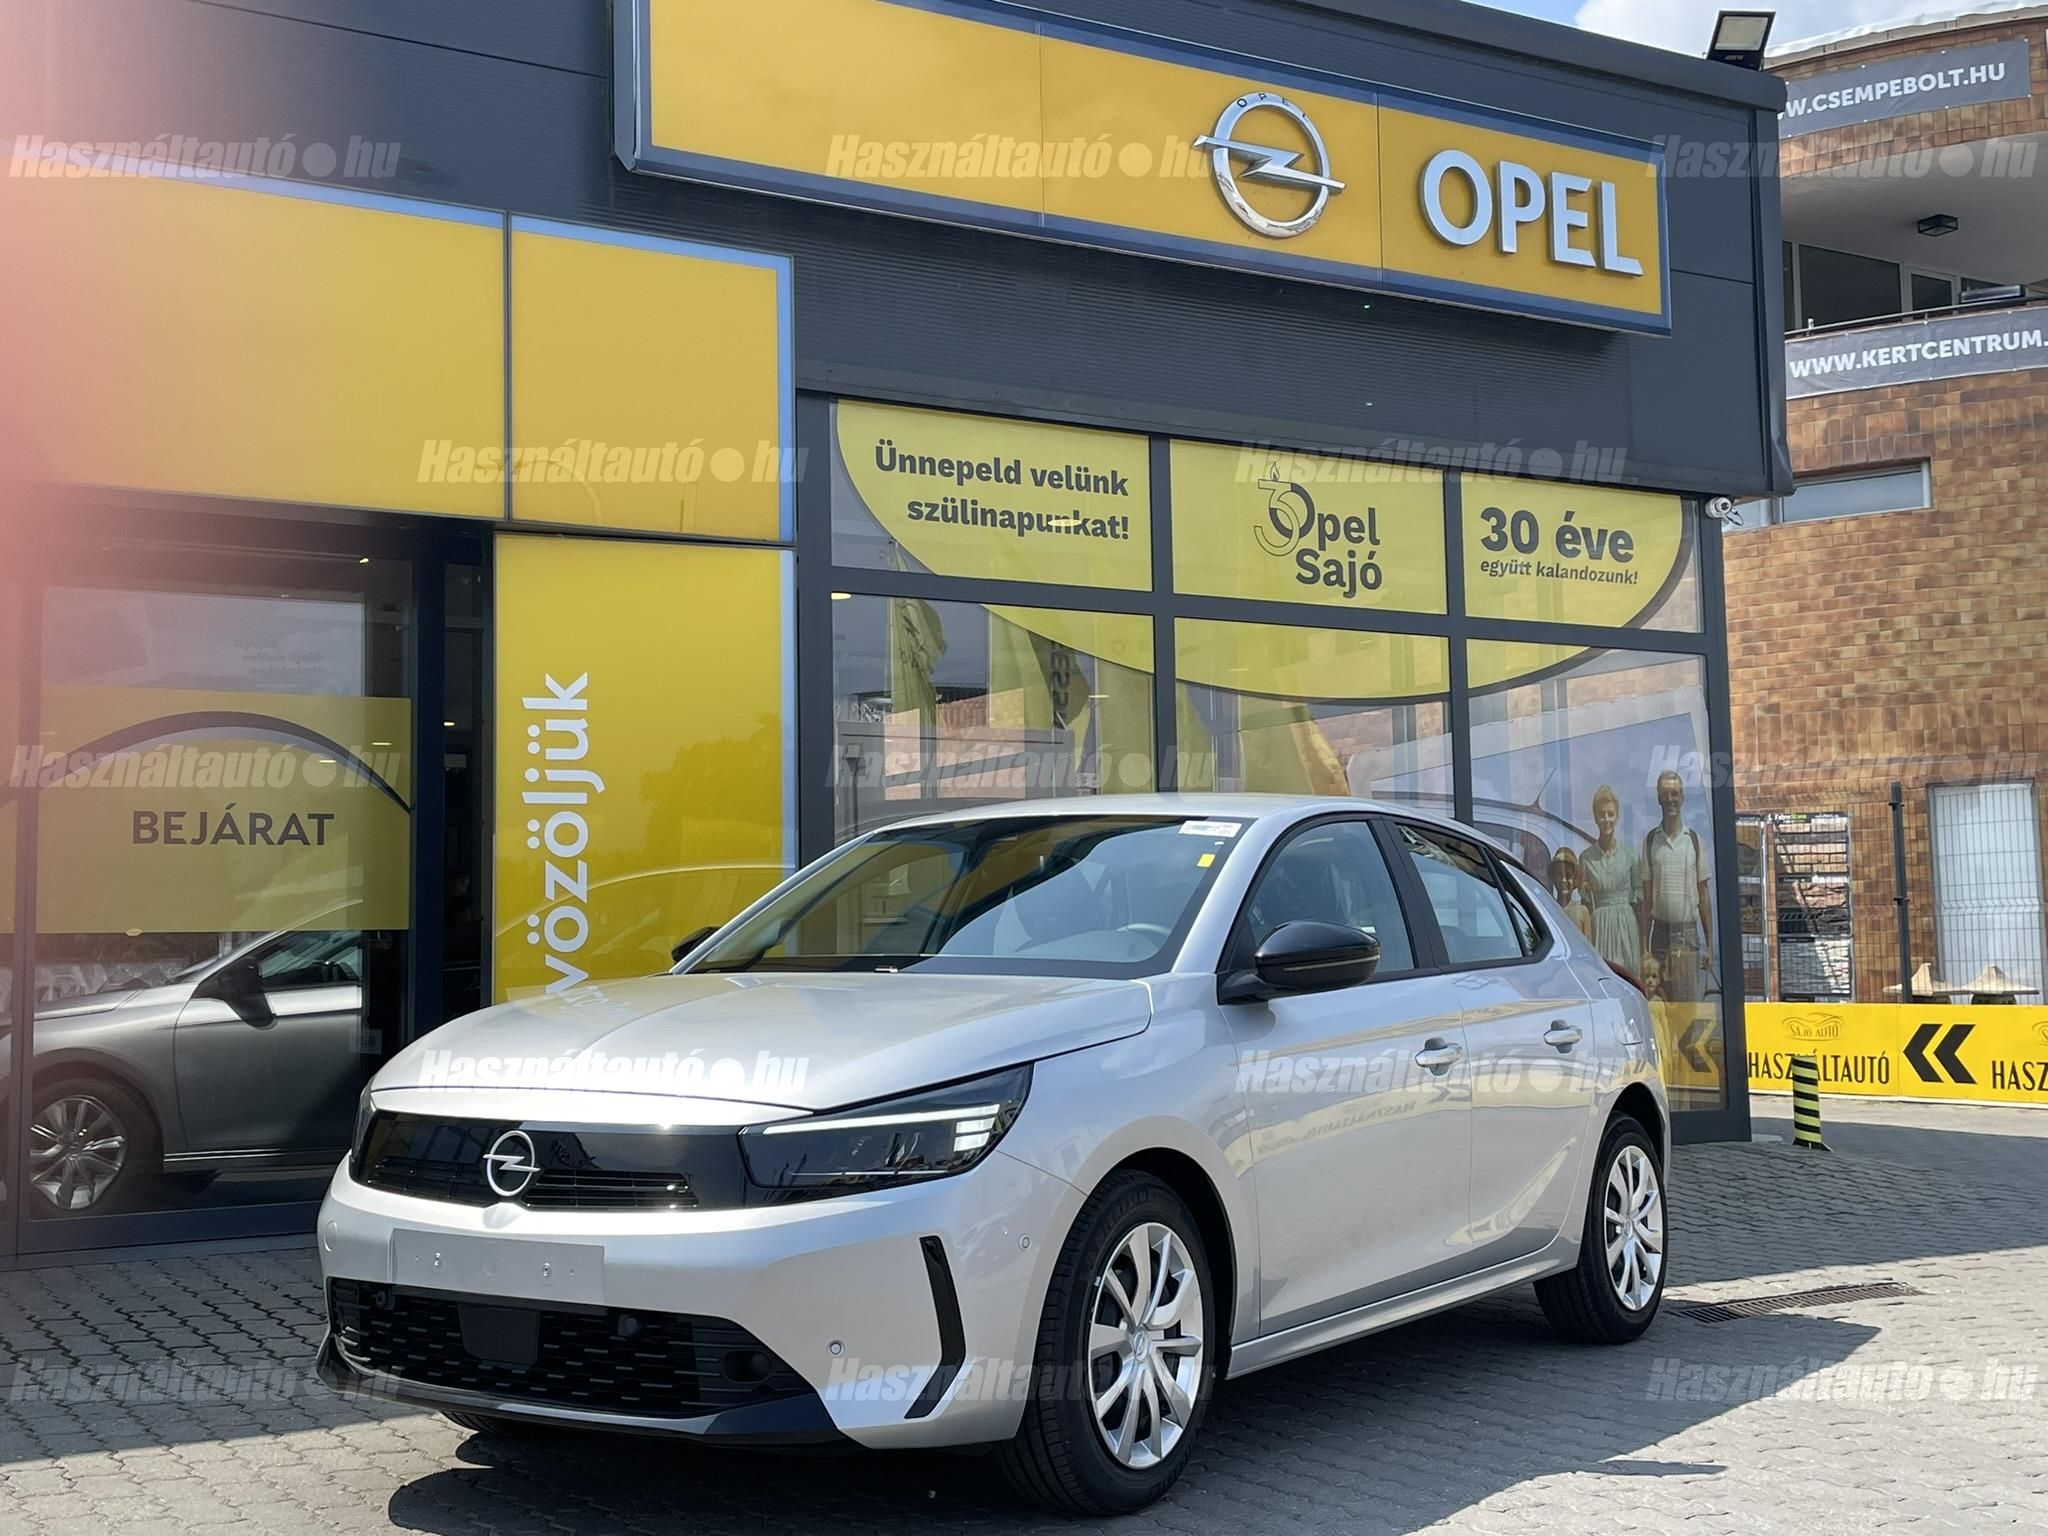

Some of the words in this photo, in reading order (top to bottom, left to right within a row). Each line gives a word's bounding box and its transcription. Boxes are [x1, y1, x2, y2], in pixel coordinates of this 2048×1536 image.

[1777, 62, 2006, 120] W.CSEMPEBOLT.HU
[1421, 149, 1643, 275] OPEL
[875, 438, 1022, 486] Ünnepeld
[1030, 465, 1128, 496] velünk
[907, 496, 1129, 540] szülinapunkat!
[1480, 506, 1540, 555] 30
[1555, 510, 1634, 563] éve
[1295, 547, 1382, 599] Sajó
[1480, 559, 1532, 578] együtt
[1536, 560, 1638, 585] kalandozunk!
[132, 802, 335, 846] BEJÁRAT
[1748, 1049, 1890, 1085] HASZLTAUTÓ
